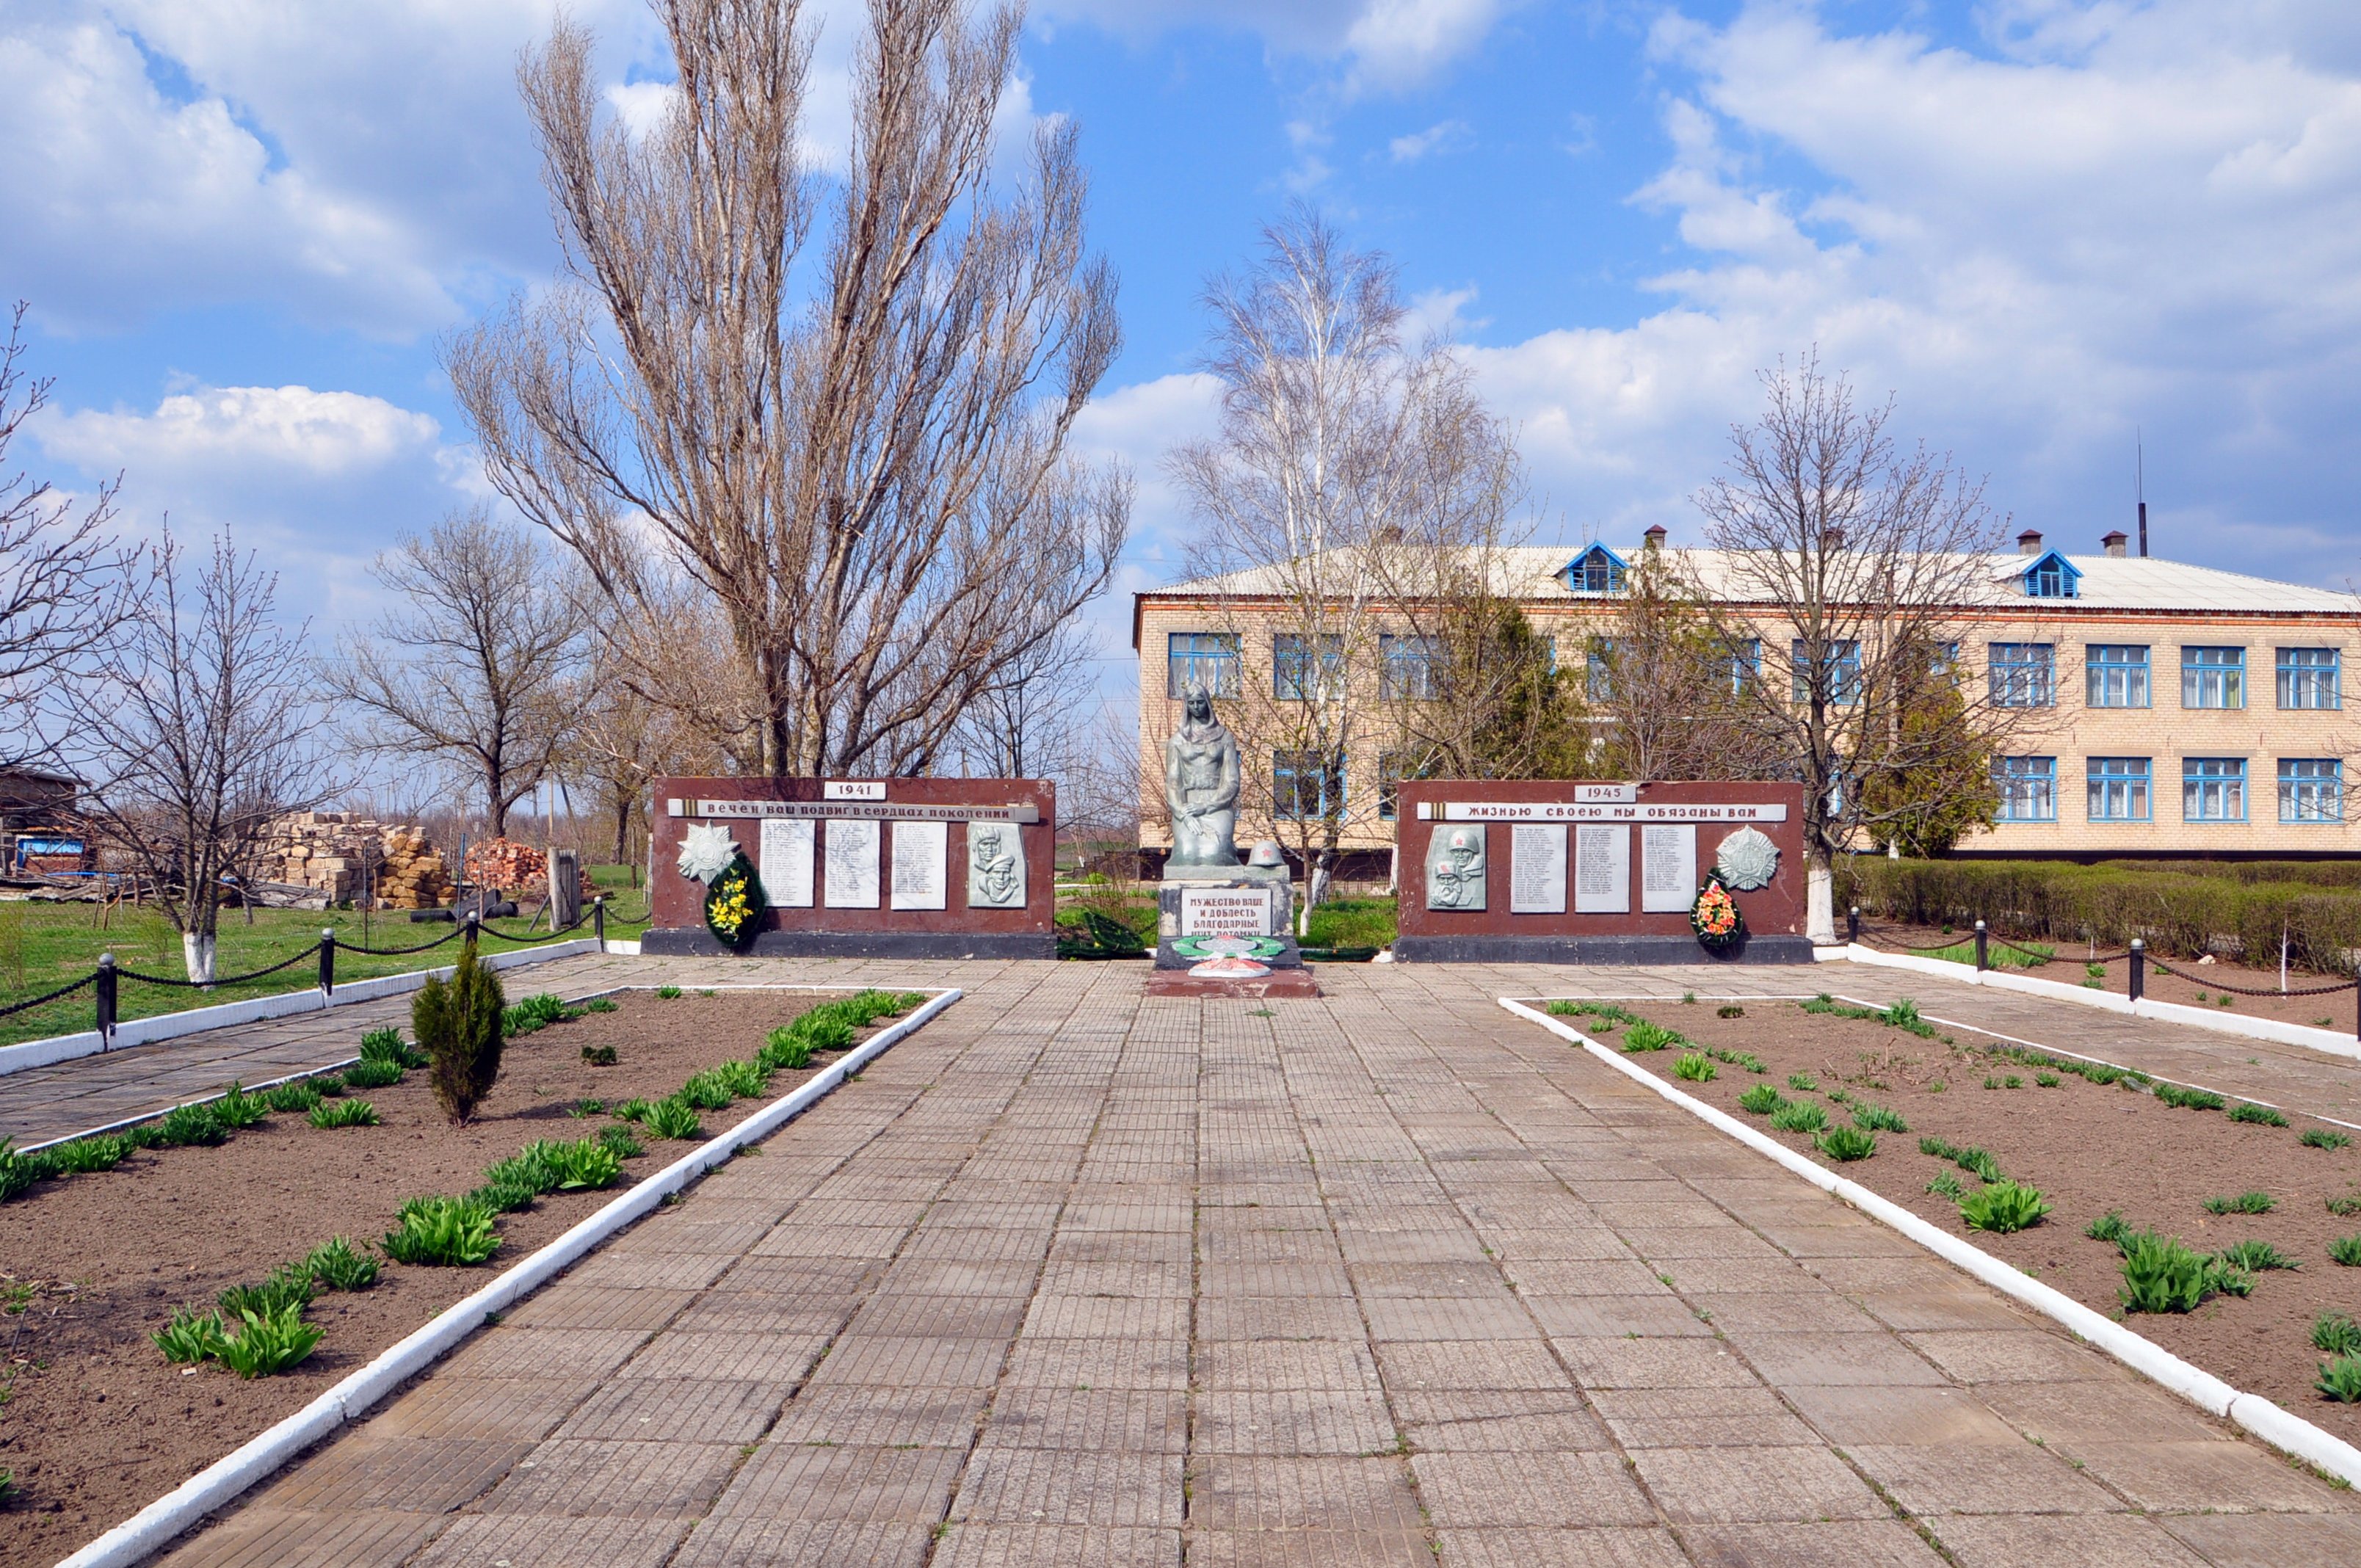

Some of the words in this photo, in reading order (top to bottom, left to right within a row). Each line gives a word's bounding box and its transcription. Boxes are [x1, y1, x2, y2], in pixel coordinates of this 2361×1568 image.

[839, 785, 871, 794] 1941
[1587, 788, 1621, 798] 1945
[864, 807, 924, 817] сердцах
[929, 809, 1009, 819] поколений
[1191, 898, 1241, 906] МУЖЕСТВО
[1242, 898, 1263, 906] ВАШЕ
[1200, 909, 1206, 917] И
[1194, 920, 1260, 929] БЛАГОДАРНЫЕ
